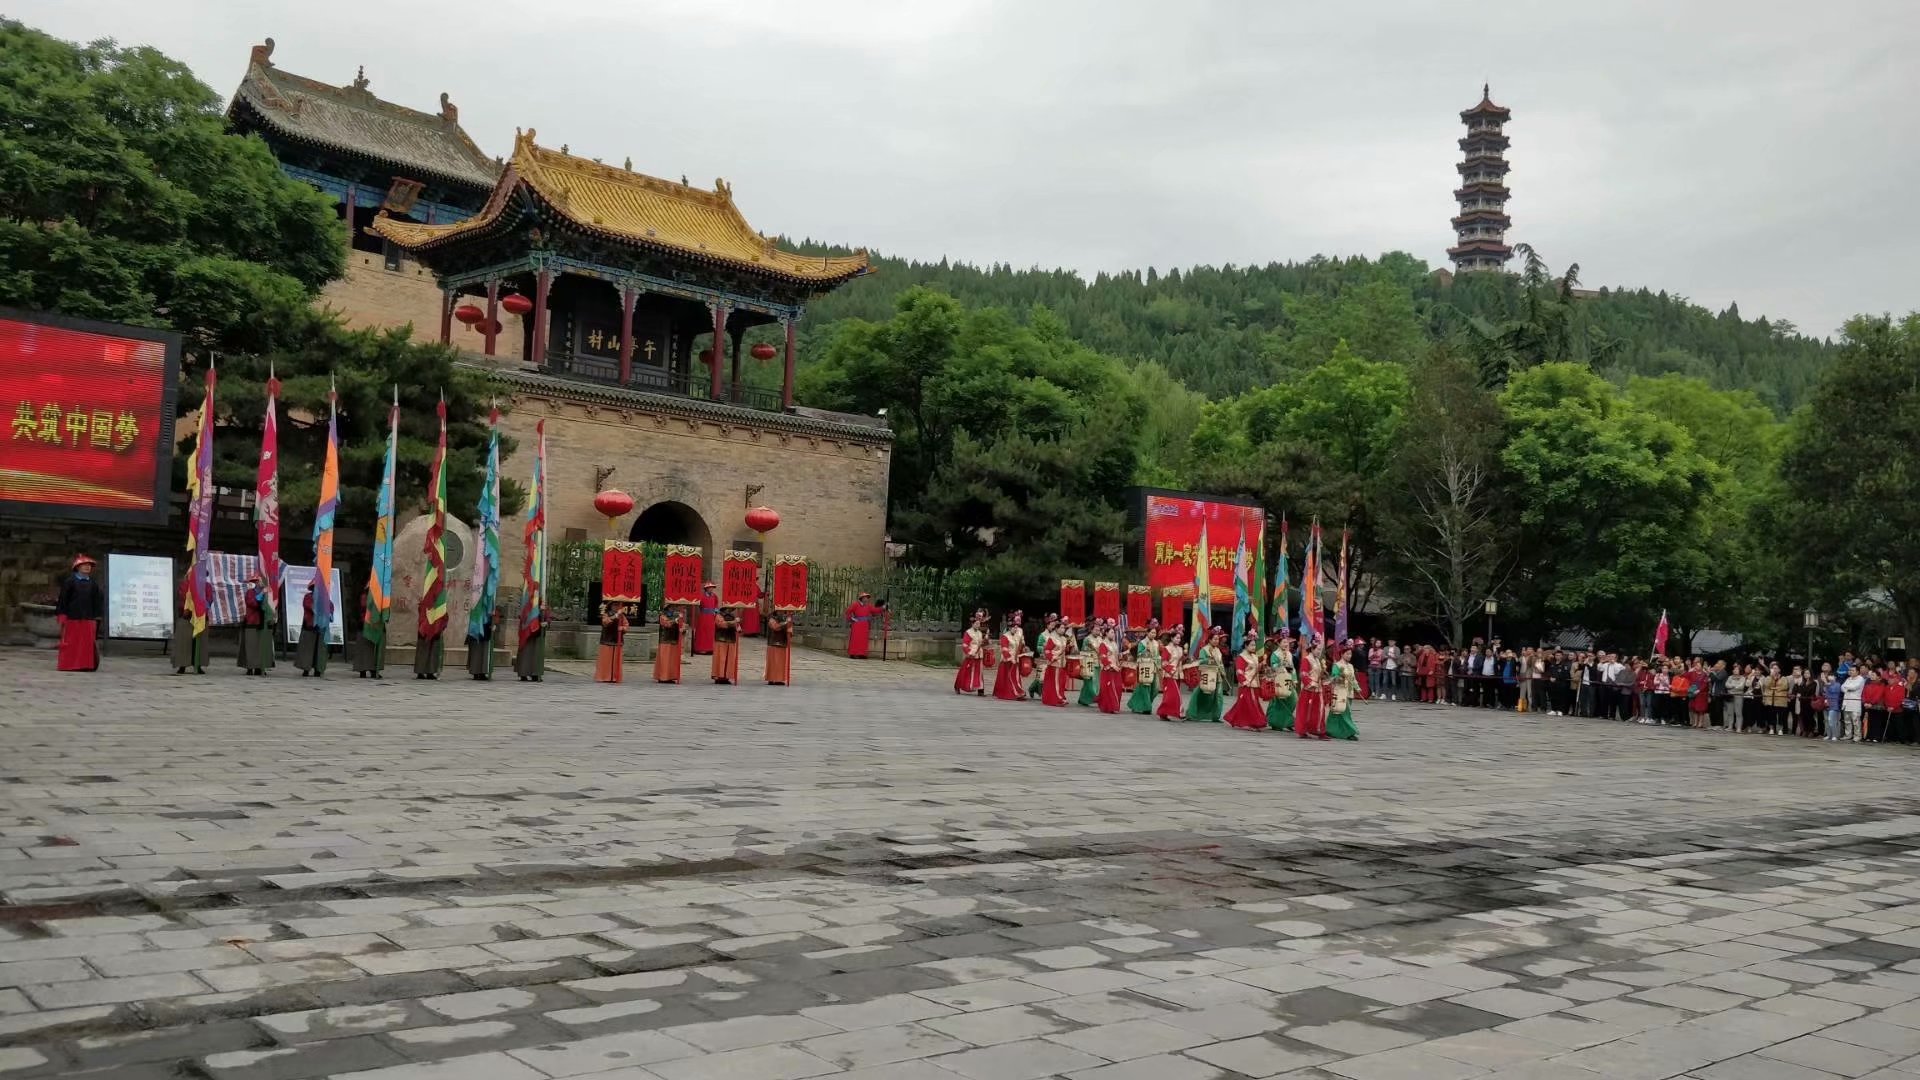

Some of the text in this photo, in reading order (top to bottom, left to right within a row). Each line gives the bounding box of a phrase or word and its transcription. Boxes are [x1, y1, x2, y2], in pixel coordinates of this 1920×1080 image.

[11, 400, 139, 451] 共筑中国梦
[1210, 546, 1254, 571] 共筑中梦
